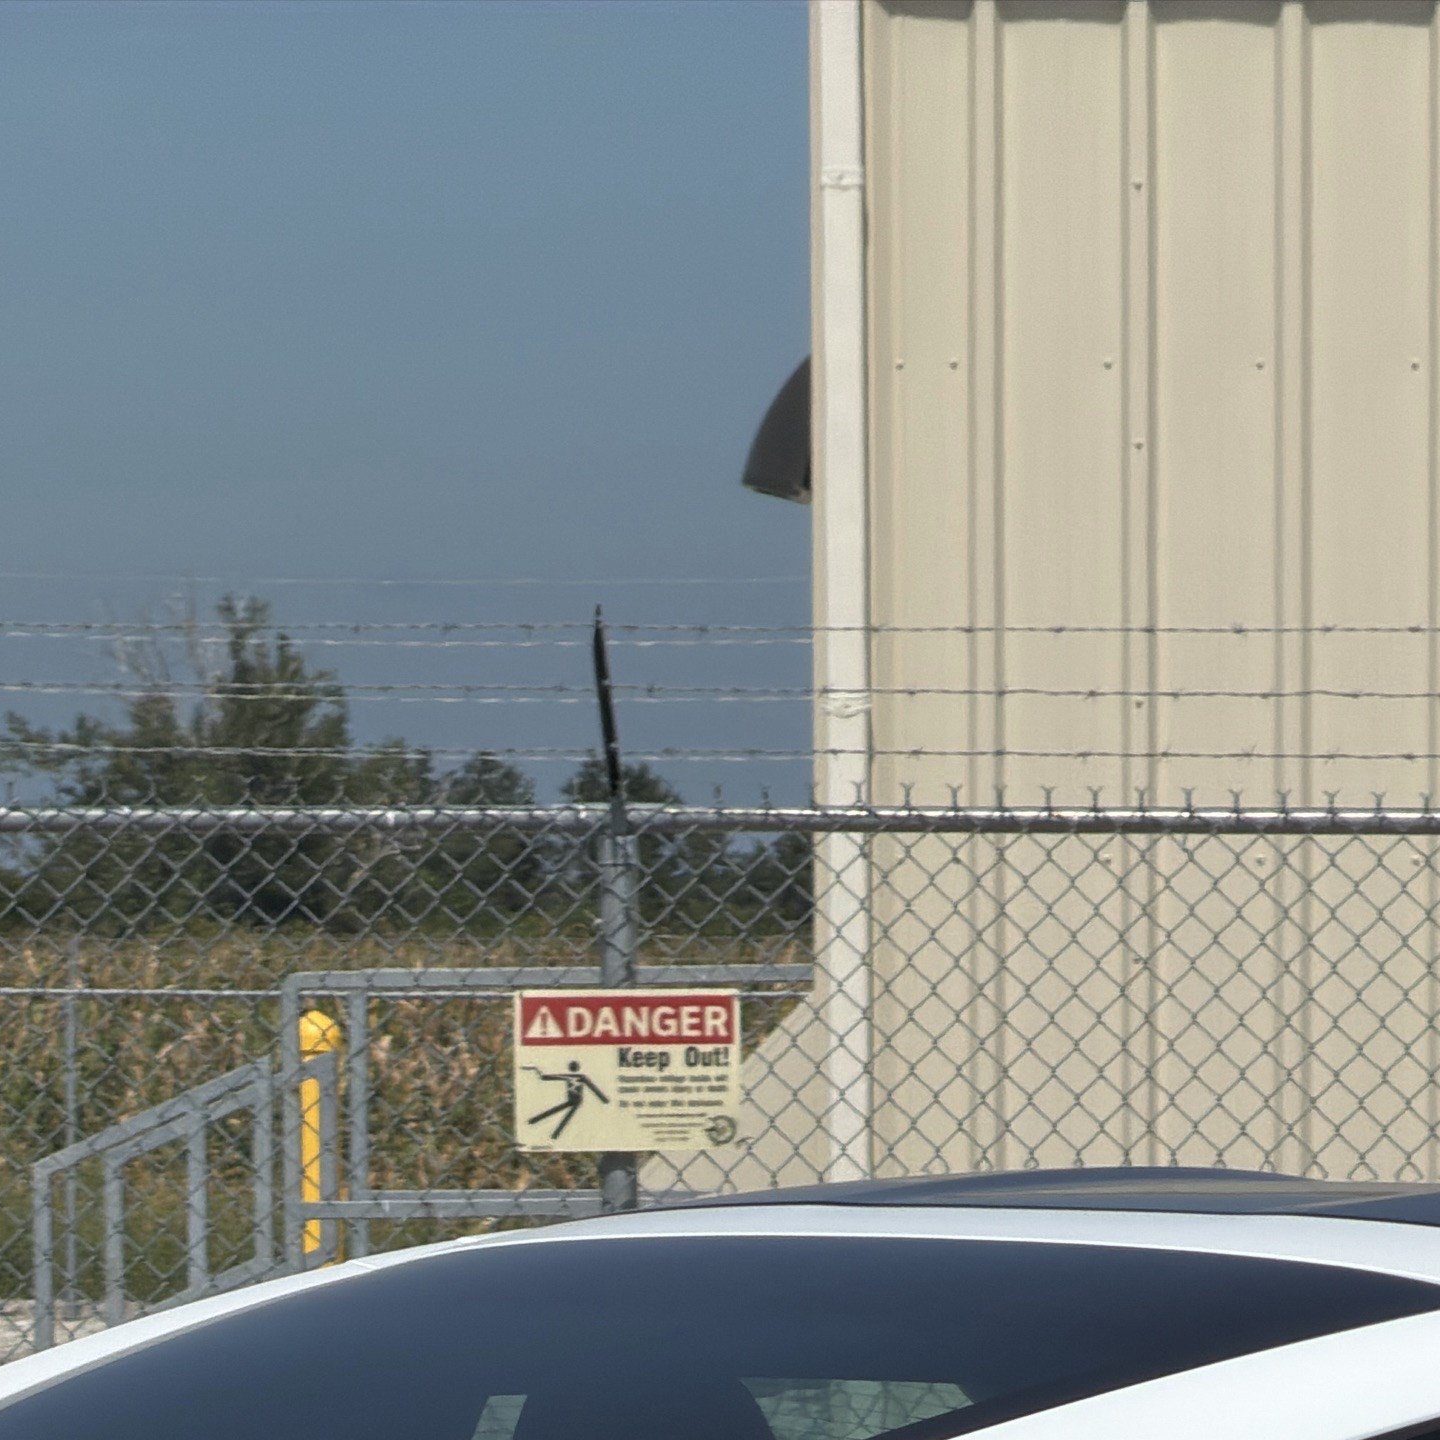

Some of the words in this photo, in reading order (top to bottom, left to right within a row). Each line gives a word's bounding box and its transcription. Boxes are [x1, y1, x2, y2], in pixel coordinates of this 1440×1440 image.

[566, 1005, 729, 1037] DANGER
[617, 1047, 670, 1071] Keep
[685, 1046, 729, 1067] Out!
